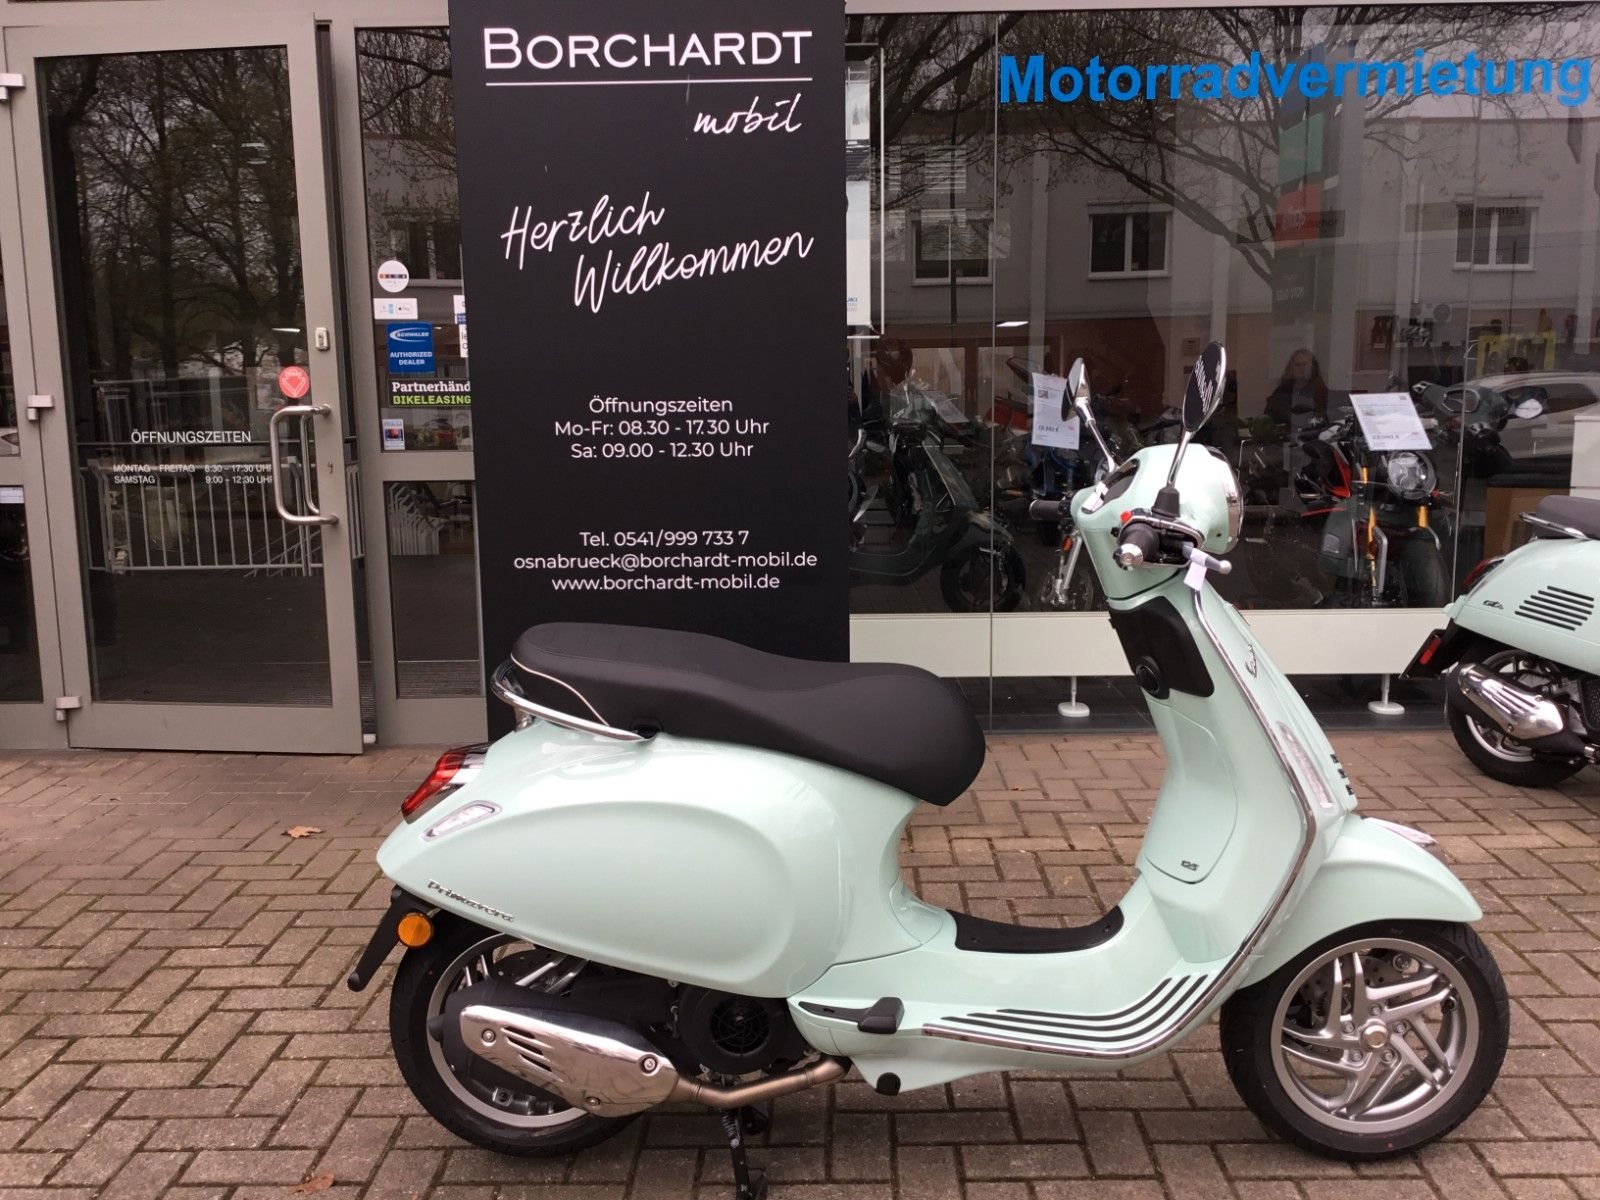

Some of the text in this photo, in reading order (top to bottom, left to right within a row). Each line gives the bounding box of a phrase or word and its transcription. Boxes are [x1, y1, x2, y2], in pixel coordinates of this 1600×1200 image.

[483, 27, 813, 70] BORCHARDT
[1000, 50, 1591, 107] Motorradvermietung
[693, 92, 803, 135] mobil
[500, 190, 665, 271] Herzlich
[573, 231, 815, 314] Willkommen
[393, 395, 472, 405] BIKELEASING
[589, 394, 733, 416] Öffnungszeiten
[130, 428, 252, 444] ÖFFNUNGSZEITEN
[554, 420, 614, 436] Mo-Fr:
[618, 419, 670, 436] 08.30
[685, 419, 730, 435] 17.30
[735, 418, 770, 435] Uhr
[570, 443, 598, 459] Sa:
[601, 442, 654, 459] 09.00
[669, 442, 715, 458] 12.30
[719, 441, 754, 457] Uhr
[113, 464, 151, 473] MONTAG
[159, 464, 196, 473] FREITAG
[232, 464, 254, 473] 17:30
[114, 475, 156, 484] SAMSTAG
[205, 475, 224, 484] 9:00
[232, 475, 255, 484] 12:30
[579, 528, 750, 549] Tel. 0541/999 733 7
[513, 549, 818, 573] osnabrueck@borchardt-mobil.de
[551, 573, 780, 591] www.borchardt-mobil.de
